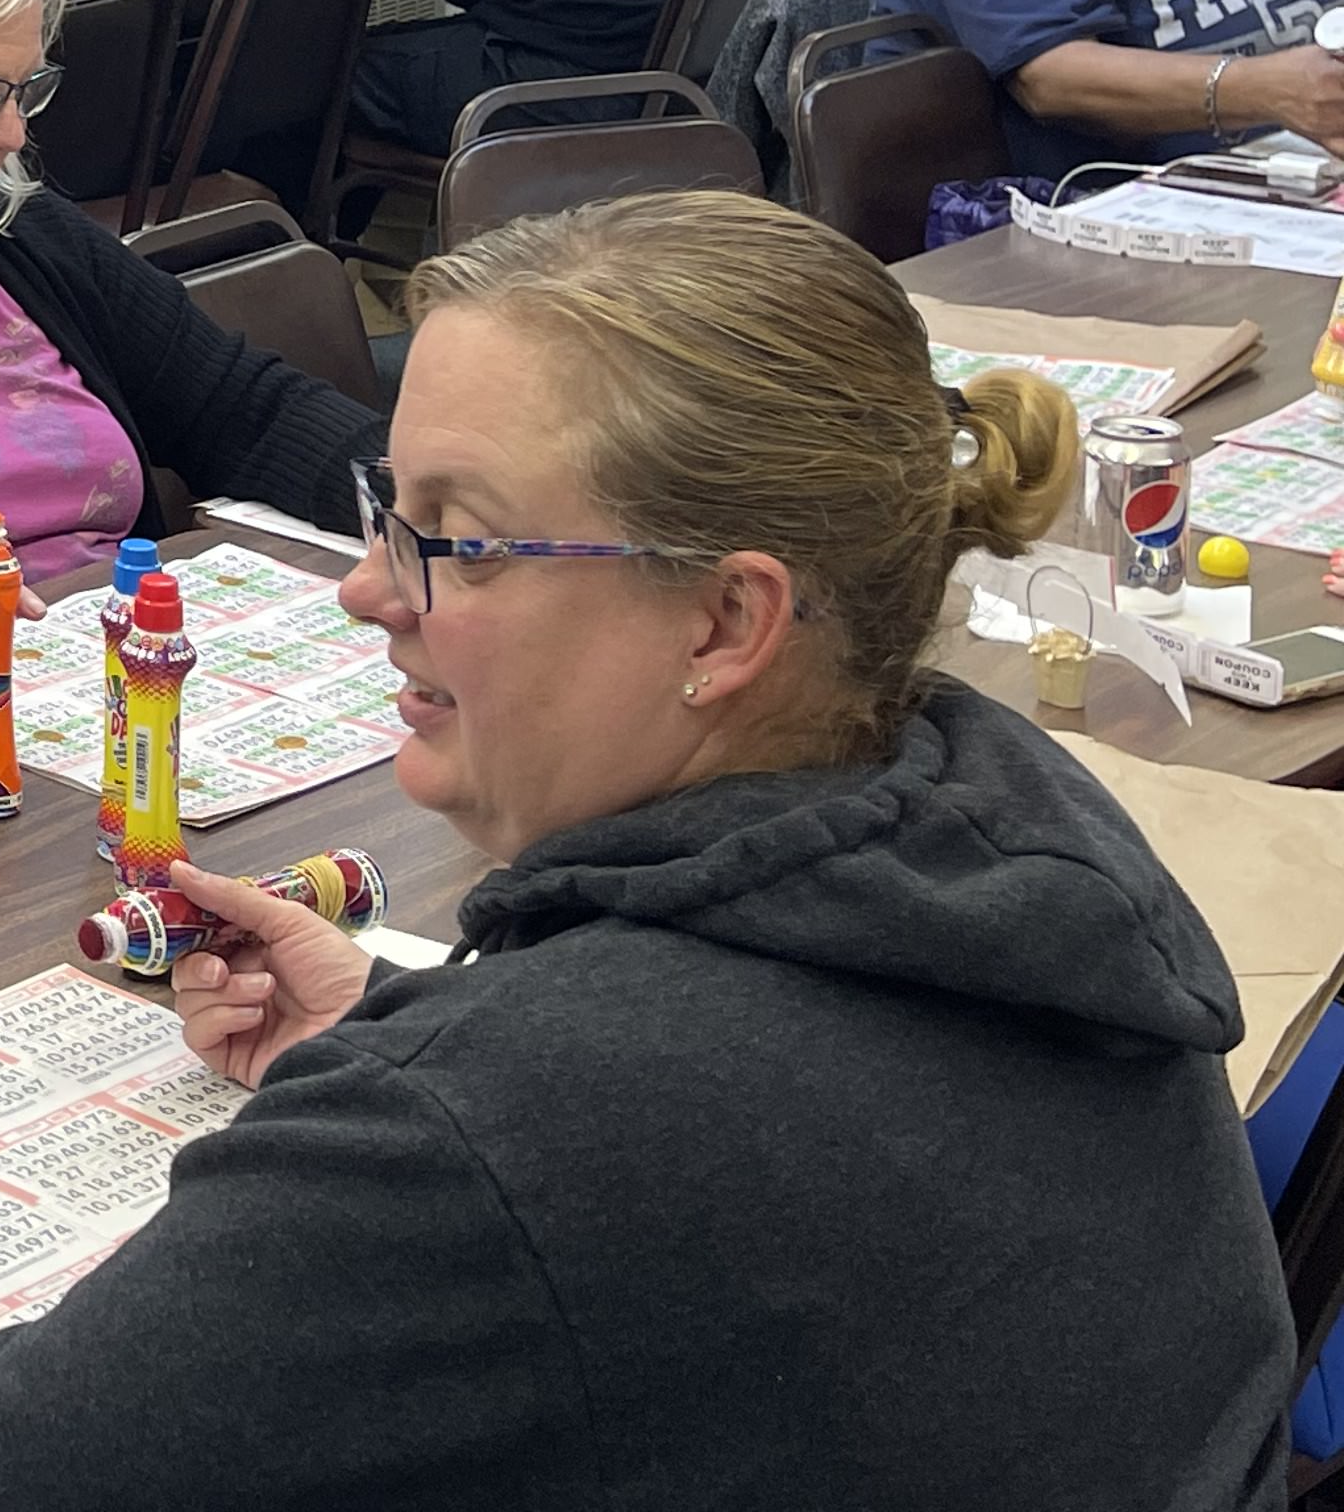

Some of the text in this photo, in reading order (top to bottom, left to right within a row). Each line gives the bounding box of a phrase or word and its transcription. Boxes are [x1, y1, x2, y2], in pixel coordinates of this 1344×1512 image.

[1214, 655, 1272, 679] COUPON
[1223, 676, 1261, 693] KEEP
[16, 1024, 45, 1037] 26
[40, 1013, 67, 1026] 34
[66, 1004, 92, 1015] 48
[88, 992, 116, 1006] 74
[20, 1003, 47, 1016] 42
[42, 992, 66, 1007] 57
[66, 983, 94, 996] 75
[21, 1002, 140, 1054] 5 17 53 64
[39, 1012, 162, 1065] 10 22 41 54 66
[63, 1023, 182, 1075] 15 21 35 56 70
